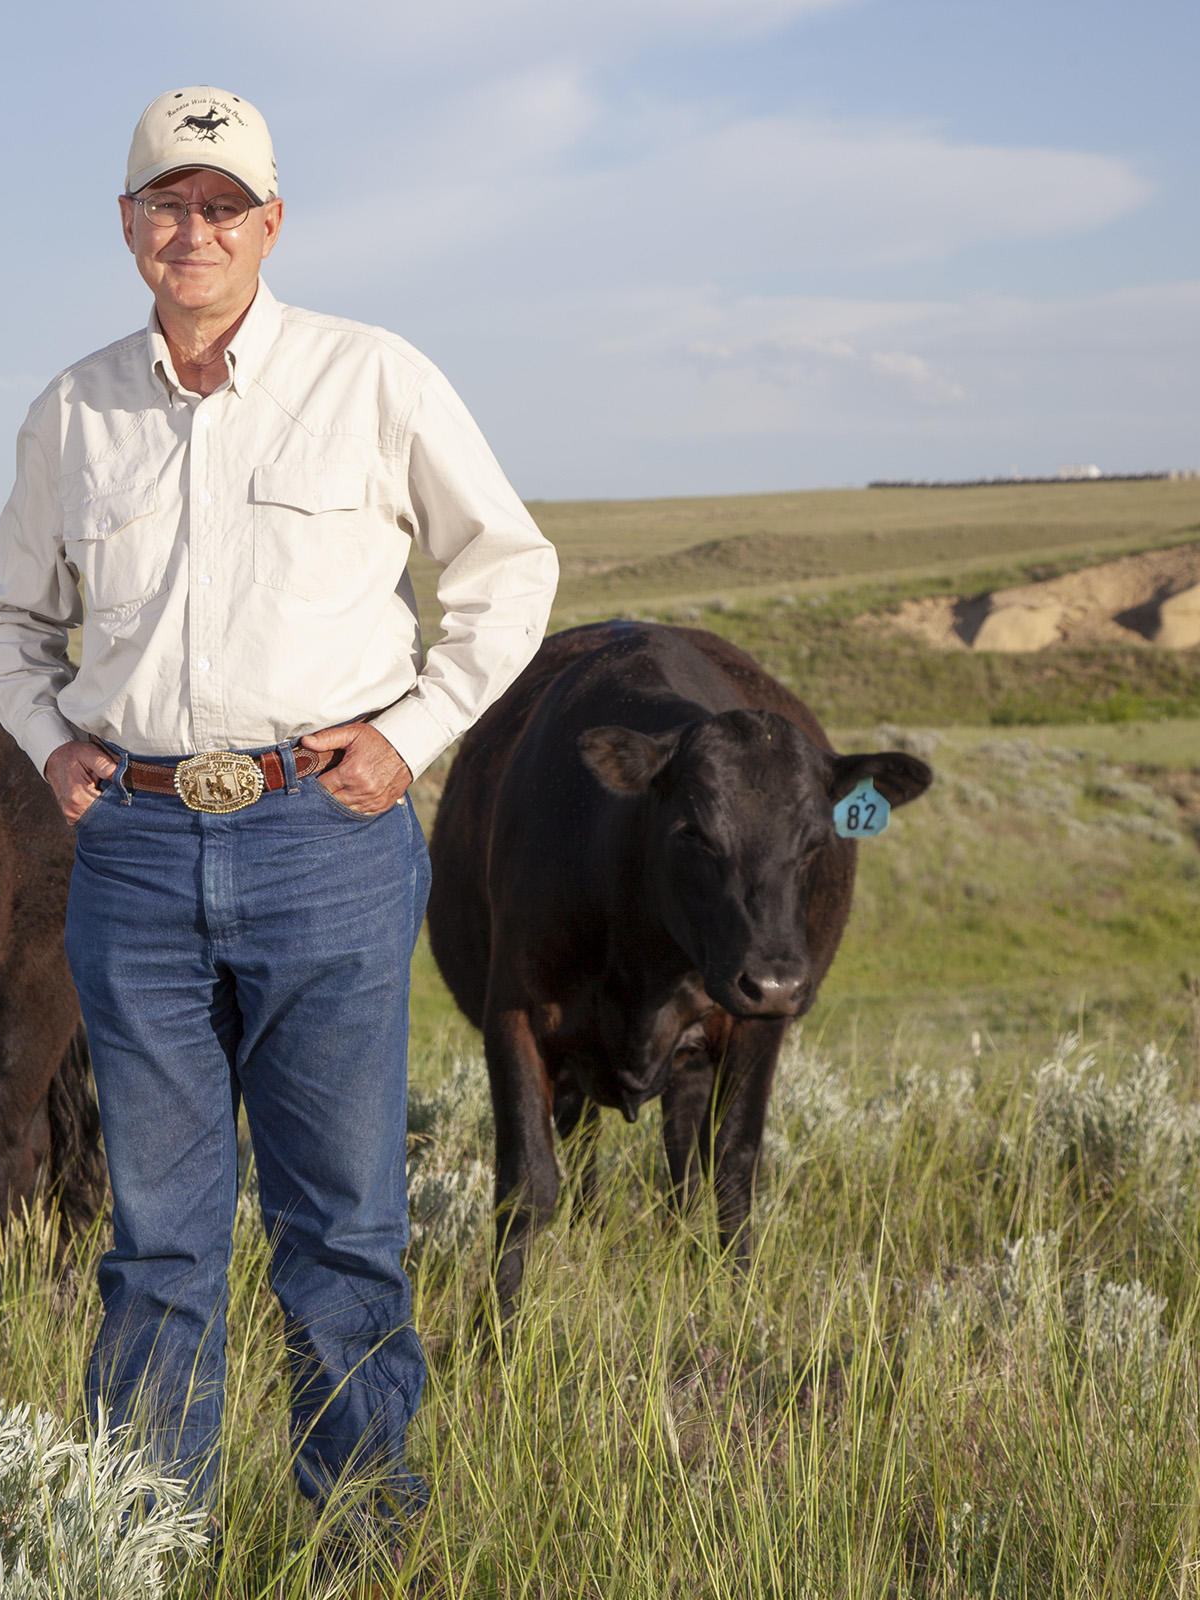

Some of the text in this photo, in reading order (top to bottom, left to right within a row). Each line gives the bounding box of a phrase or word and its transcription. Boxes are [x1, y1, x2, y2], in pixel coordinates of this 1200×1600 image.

[212, 761, 234, 769] STATE
[235, 762, 251, 772] FAIR
[847, 804, 877, 831] 82
